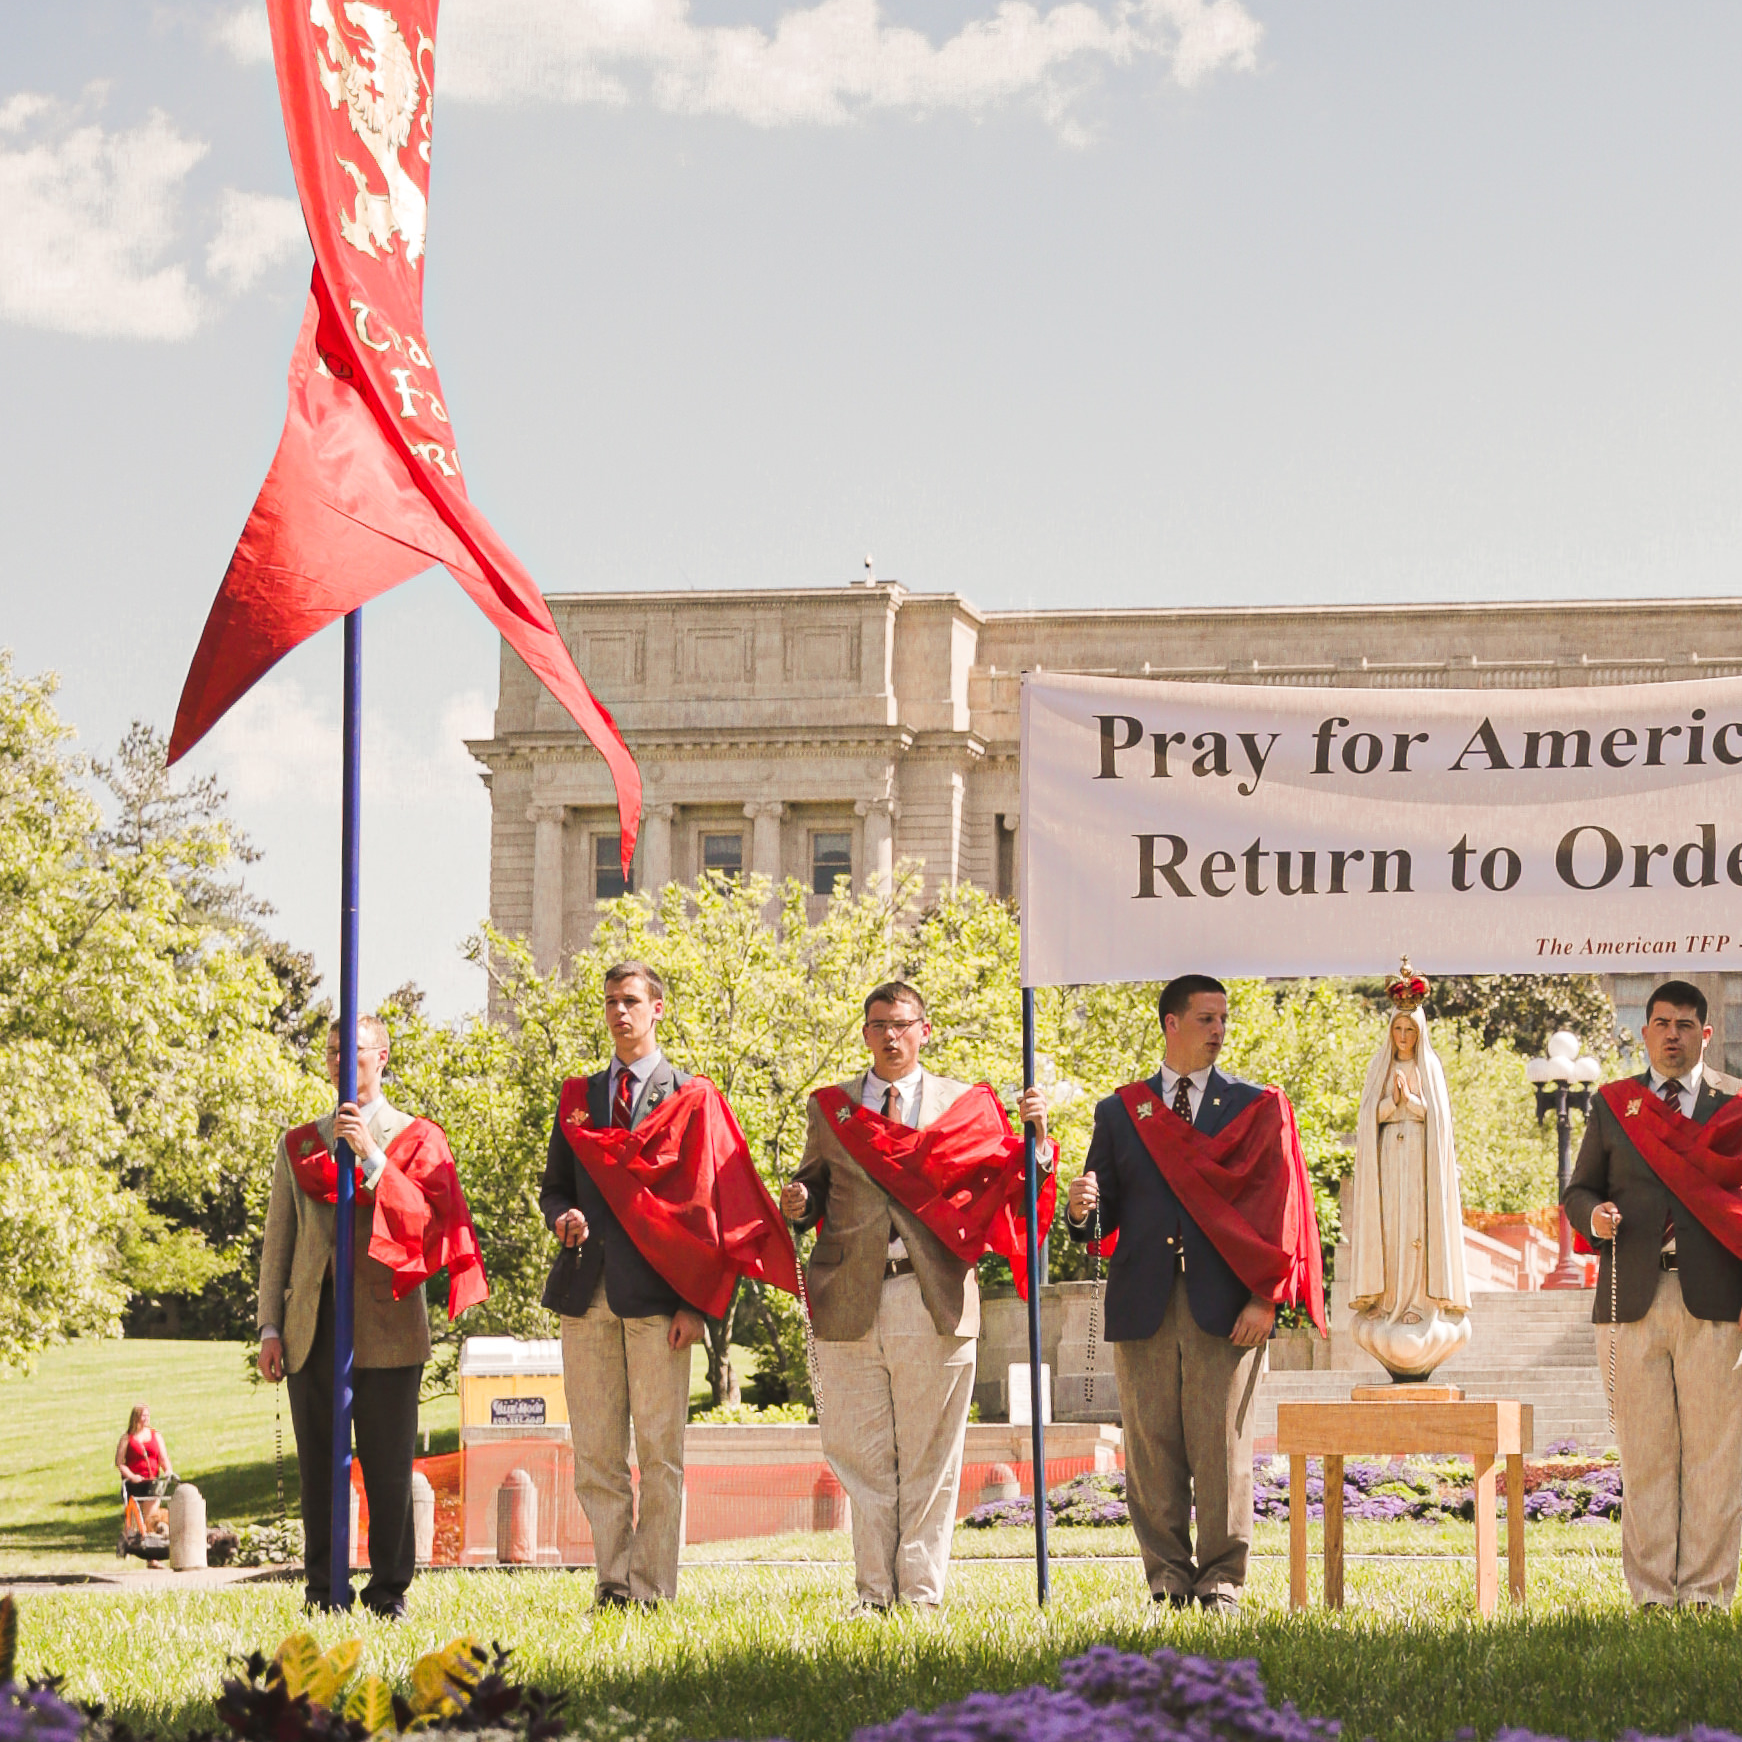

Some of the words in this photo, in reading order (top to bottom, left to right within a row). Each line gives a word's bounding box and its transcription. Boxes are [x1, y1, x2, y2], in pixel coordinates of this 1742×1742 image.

[1092, 716, 1281, 796] Pray
[1310, 717, 1429, 774] for
[1131, 834, 1414, 898] Return
[1448, 834, 1521, 891] to
[1536, 937, 1573, 956] The
[1579, 936, 1677, 955] American
[1685, 935, 1730, 953] TFP
